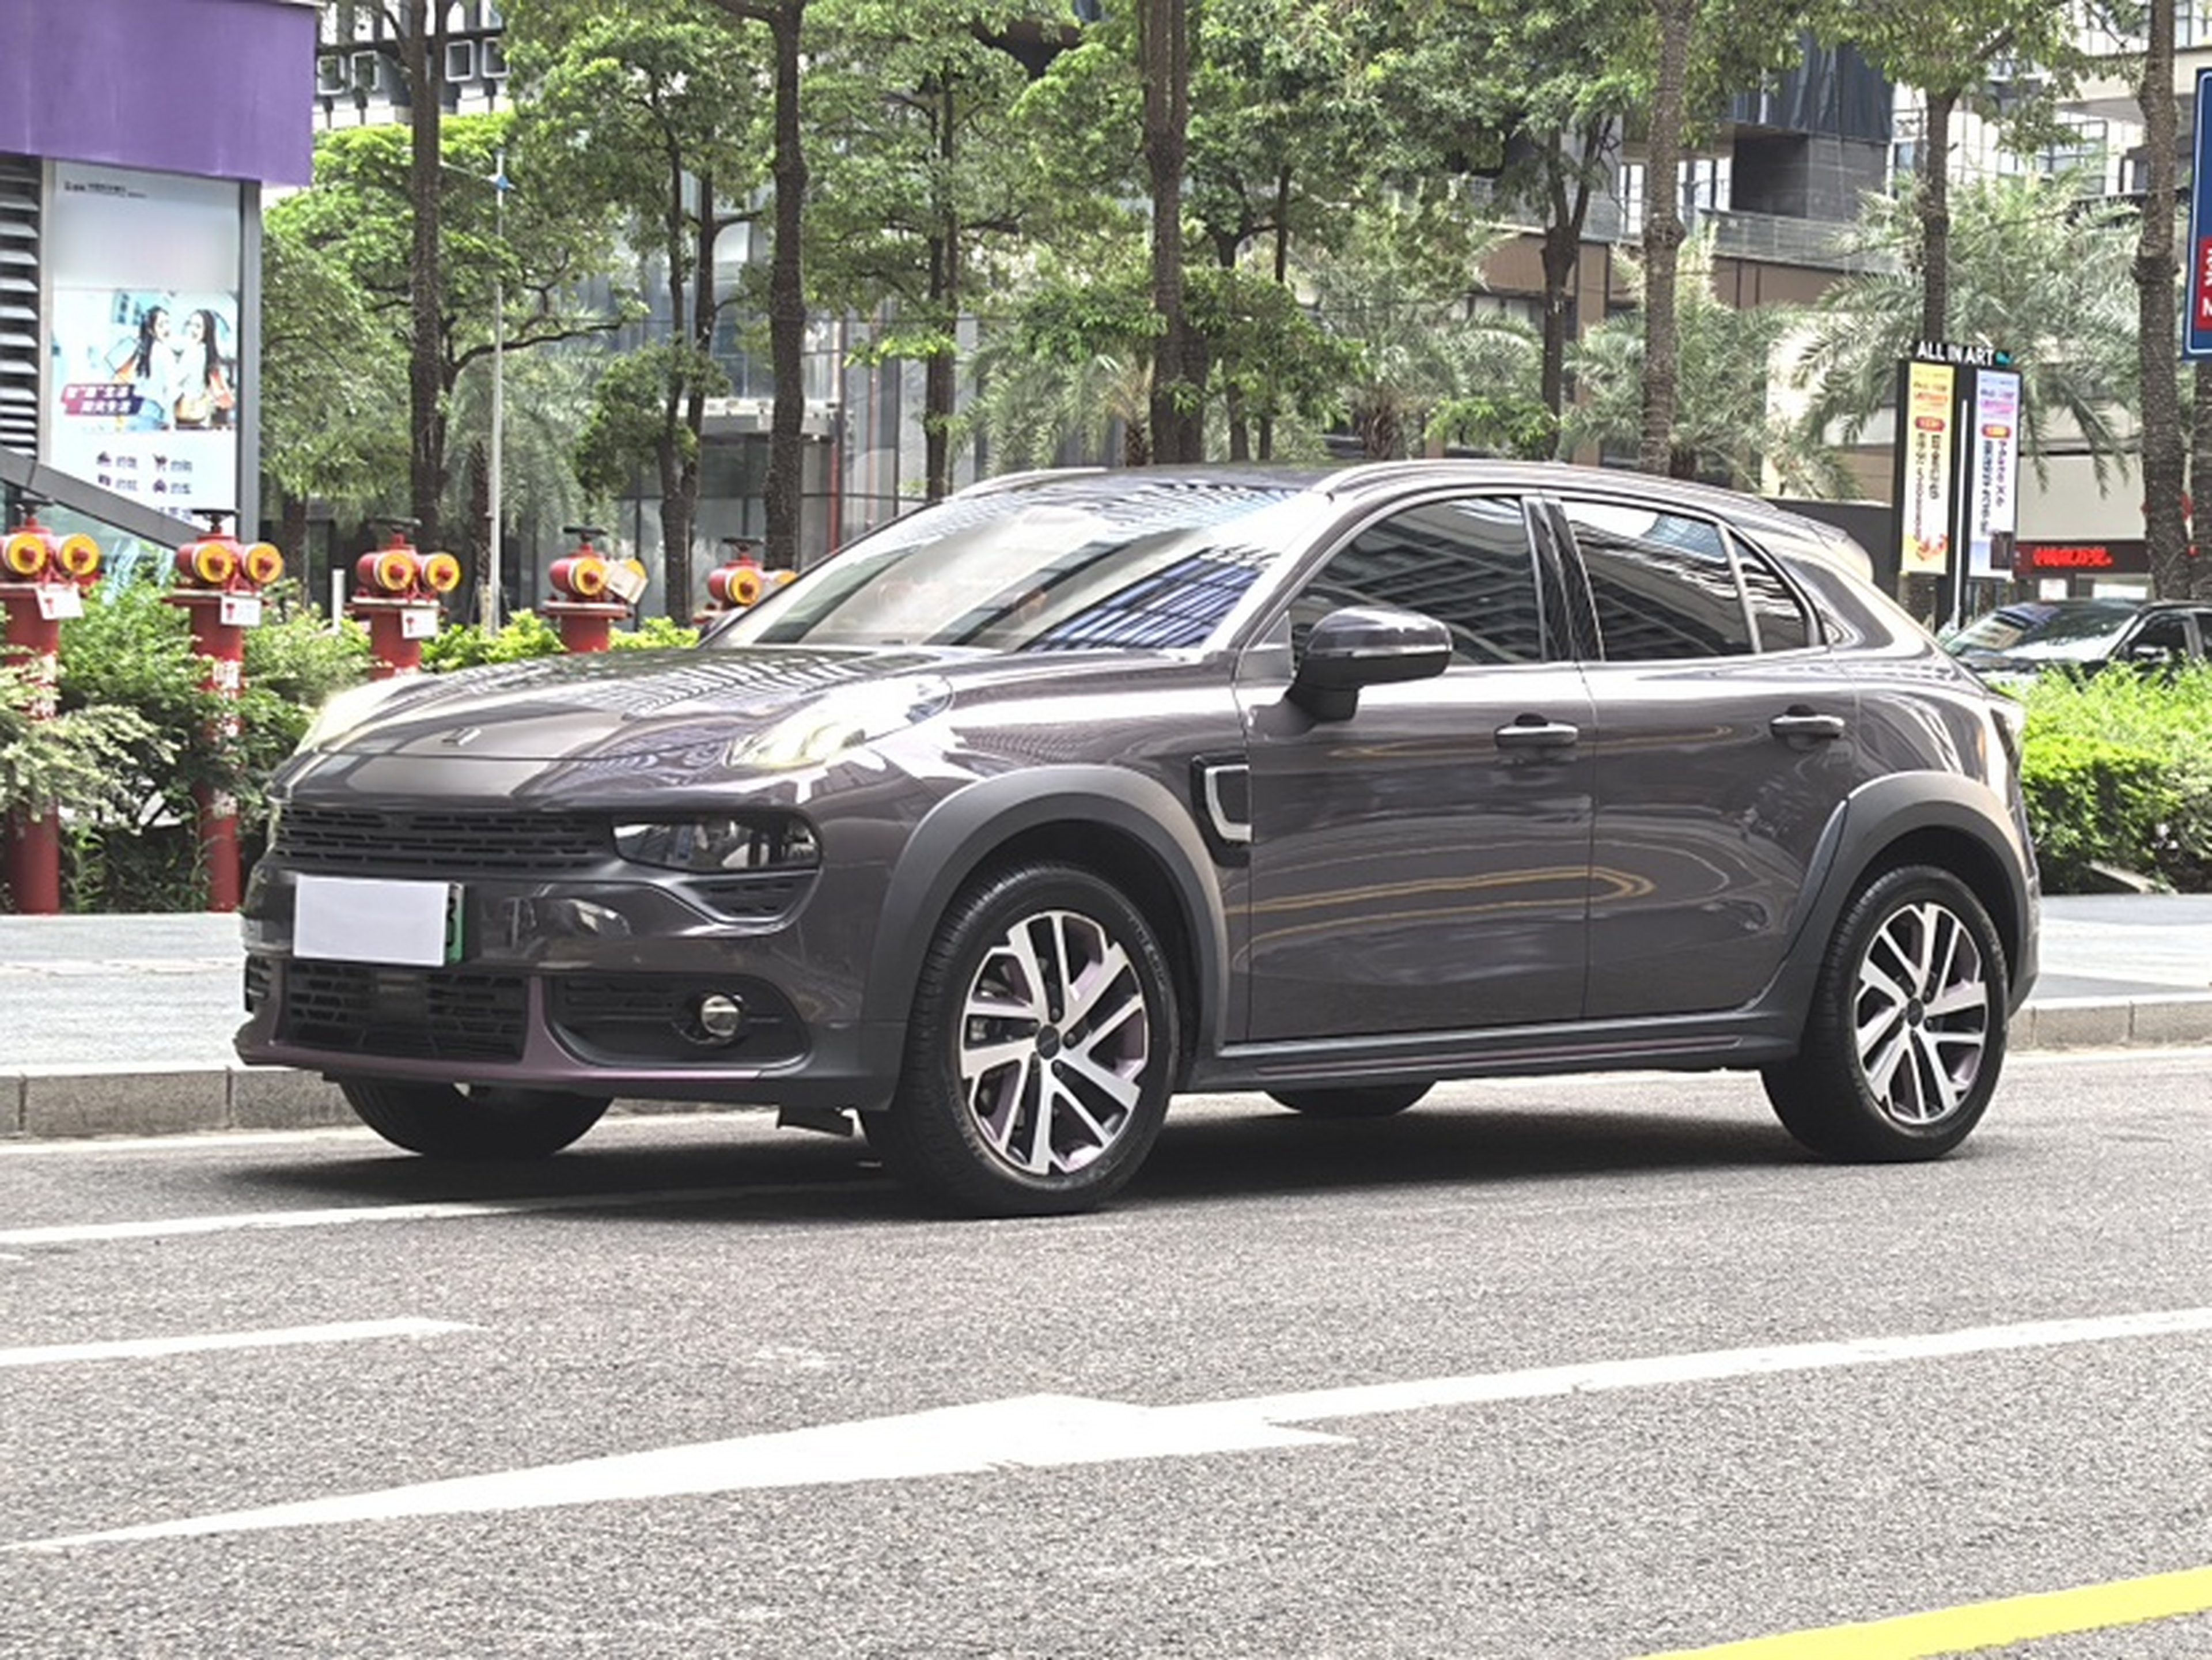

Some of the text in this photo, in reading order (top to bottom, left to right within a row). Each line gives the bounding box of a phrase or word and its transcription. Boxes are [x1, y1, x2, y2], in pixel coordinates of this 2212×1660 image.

[1916, 341, 1994, 366] ALL IN ART
